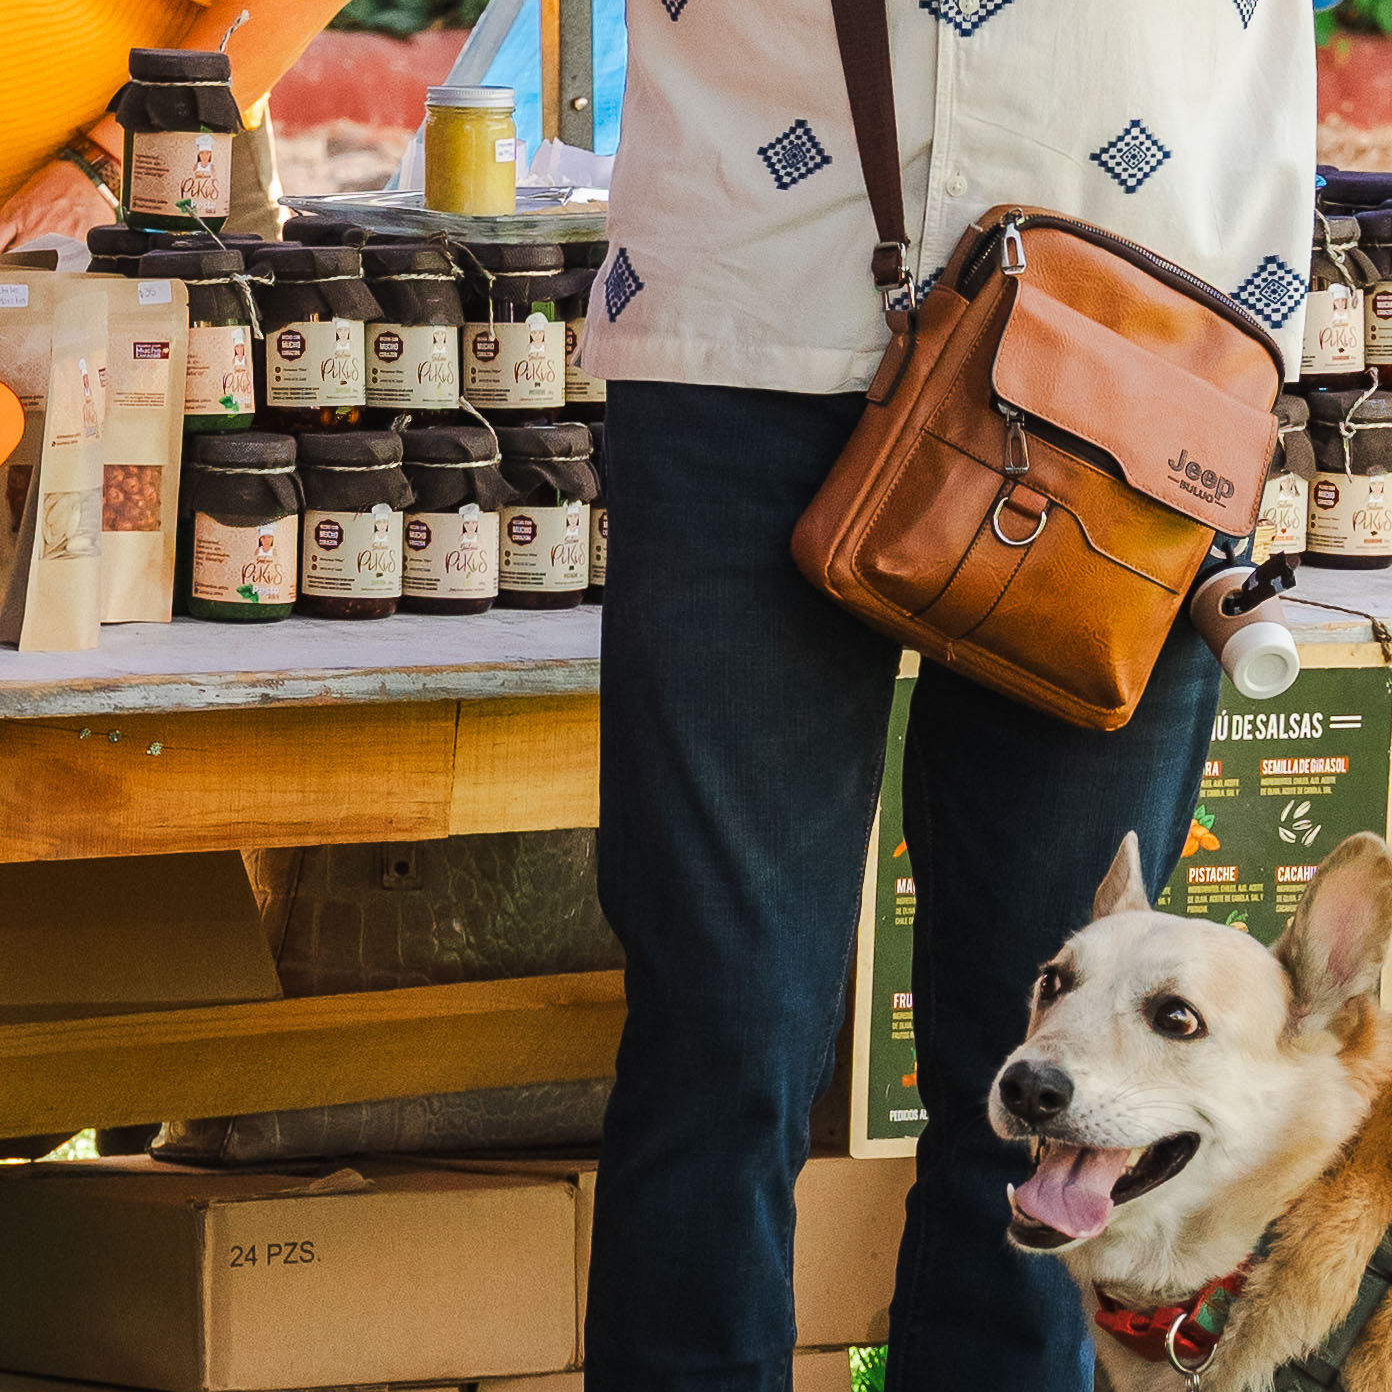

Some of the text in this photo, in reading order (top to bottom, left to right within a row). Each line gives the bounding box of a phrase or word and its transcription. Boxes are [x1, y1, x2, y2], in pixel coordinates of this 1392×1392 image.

[1168, 449, 1235, 500] Jeep
[1231, 714, 1254, 740] DE
[1255, 712, 1324, 740] SALSAS
[1262, 759, 1299, 775] SEMILLA
[1310, 757, 1347, 774] GIRASOL
[1188, 866, 1236, 882] PISTACHE
[230, 1240, 321, 1268] 24 PZS.
